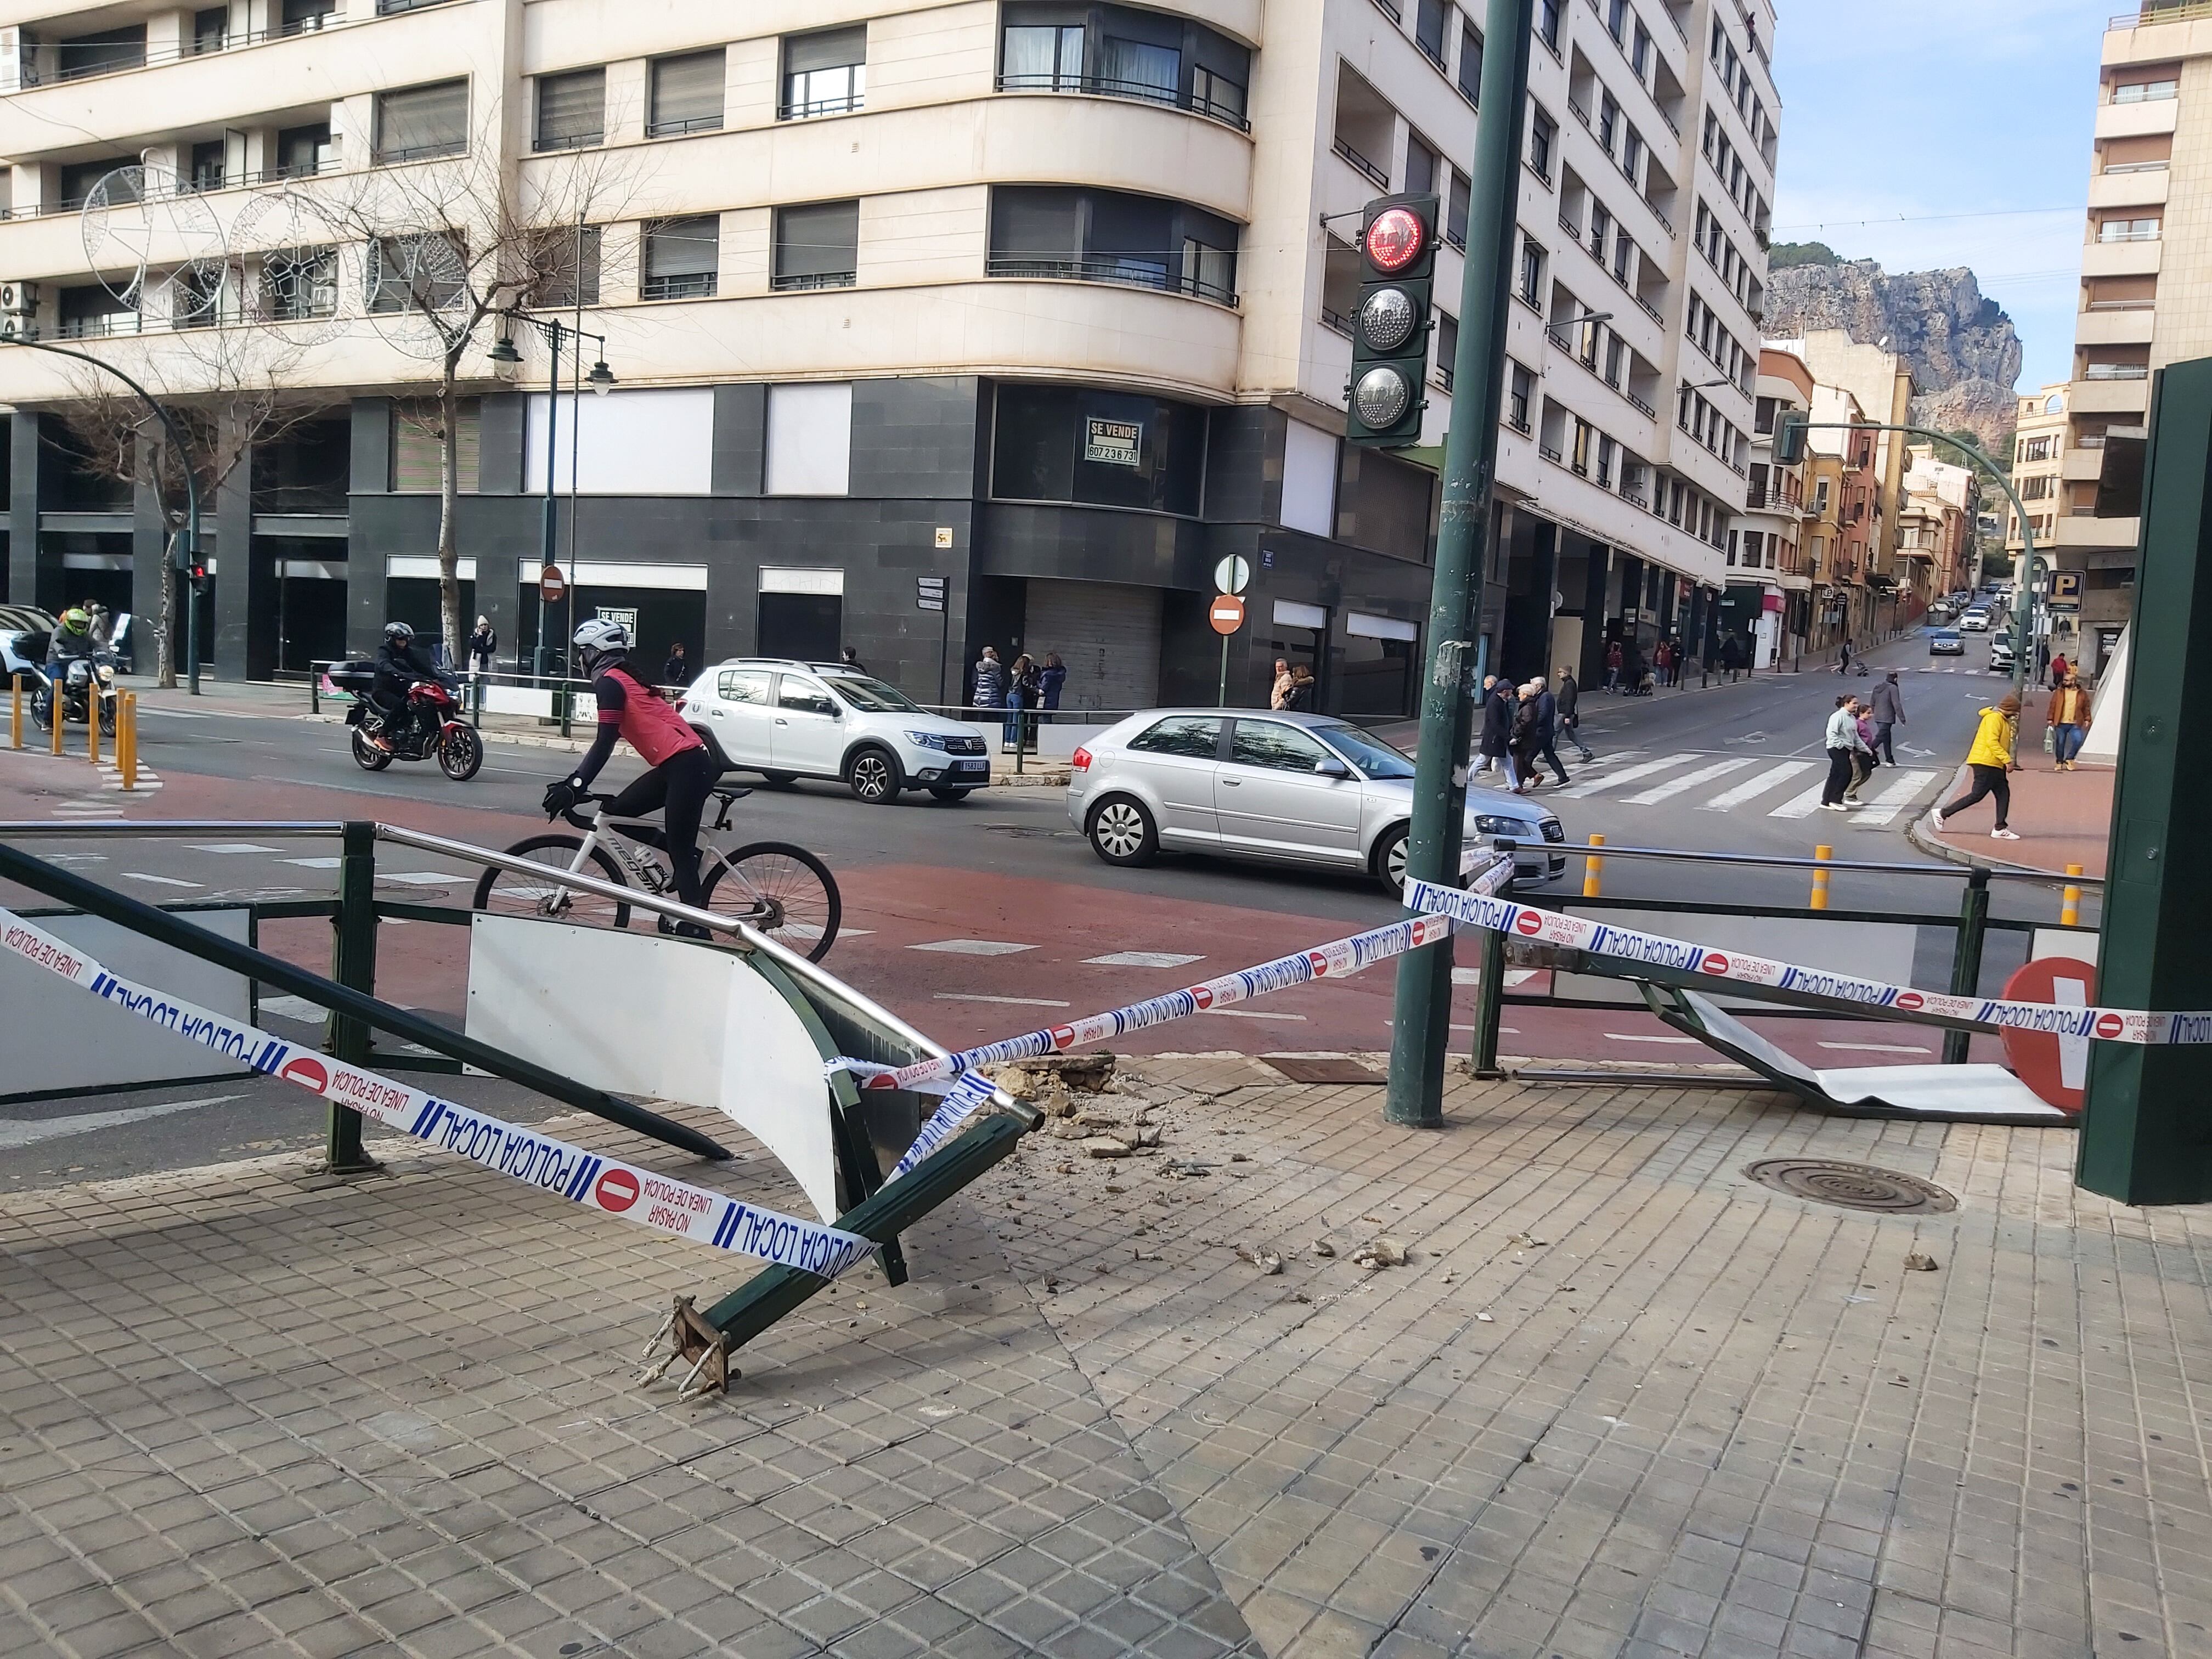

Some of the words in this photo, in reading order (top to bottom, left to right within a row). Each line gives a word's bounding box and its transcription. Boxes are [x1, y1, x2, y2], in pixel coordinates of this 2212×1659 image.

[1091, 422, 1103, 435] SE
[1106, 425, 1137, 439] VENDE
[1089, 446, 1102, 457] 607
[1105, 448, 1121, 460] 236
[2055, 575, 2076, 596] P
[601, 612, 610, 620] SE
[611, 612, 634, 623] VENDE
[607, 837, 661, 896] megam
[1426, 887, 1460, 917] LOCAL
[1461, 896, 1503, 928] POLICIA
[1544, 914, 1564, 929] POLICIA
[1562, 919, 1572, 931] DE
[1571, 922, 1587, 934] LINEA
[5, 925, 44, 957] POLICIA
[1380, 927, 1405, 957] POLICIA
[1549, 929, 1566, 941] PASAR
[1565, 933, 1575, 944] NO
[1606, 930, 1643, 957] LOCAL
[38, 944, 57, 965] DE
[1359, 935, 1383, 962] LOCAL
[1644, 938, 1688, 968] POLICIA
[54, 951, 83, 979] LINEA
[1274, 958, 1304, 987] POLICIA
[1730, 956, 1751, 972] POLICIA
[1750, 961, 1760, 973] DE
[1759, 962, 1776, 975] LINEA
[1248, 967, 1278, 994] LOCAL
[1797, 972, 1834, 995] LOCAL
[1835, 979, 1882, 1003] POLICIA
[116, 986, 180, 1029] LOCAL
[1150, 992, 1186, 1023] POLICIA
[1926, 996, 1947, 1007] POLICIA
[1947, 998, 1956, 1008] DE
[1955, 1000, 1974, 1010] LINEA
[1994, 1005, 2033, 1028] LOCAL
[2033, 1008, 2080, 1034] POLICIA
[182, 1013, 259, 1064] POLICIA
[2183, 1016, 2211, 1042] LOCAL
[331, 1069, 370, 1099] POLICIA
[365, 1082, 383, 1104] DE
[381, 1087, 410, 1113] LINEA
[439, 1110, 504, 1165] LOCAL
[499, 1133, 576, 1193] POLICIA
[643, 1178, 677, 1204] POLICIA
[674, 1188, 689, 1207] DE
[688, 1192, 713, 1215] LINEA
[648, 1204, 678, 1229] PASAR
[676, 1212, 692, 1233] NO
[742, 1211, 799, 1263] LOCAL
